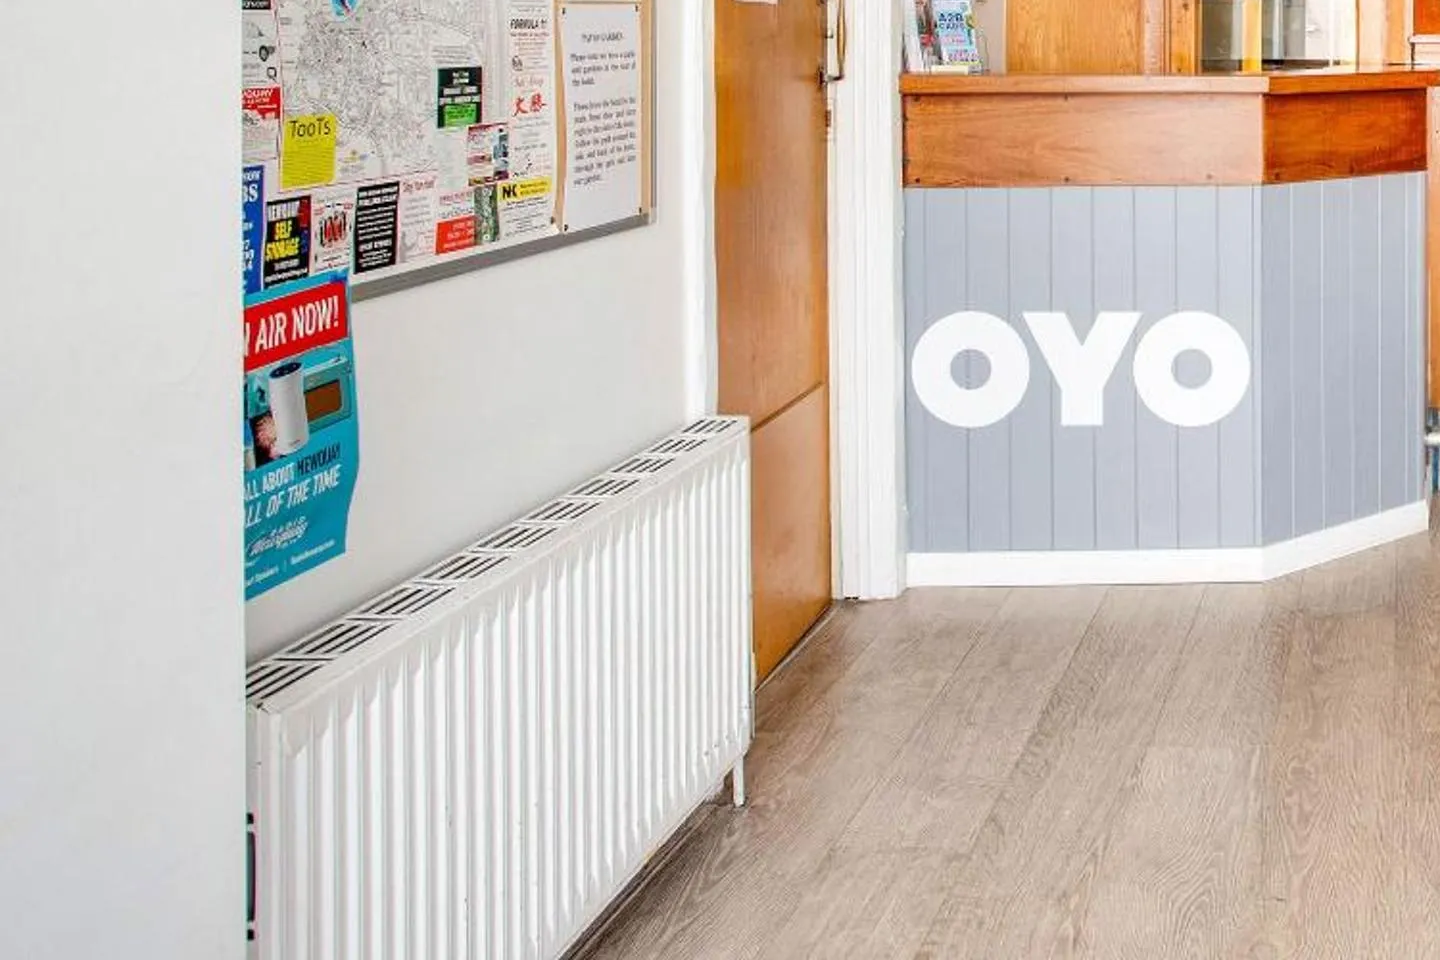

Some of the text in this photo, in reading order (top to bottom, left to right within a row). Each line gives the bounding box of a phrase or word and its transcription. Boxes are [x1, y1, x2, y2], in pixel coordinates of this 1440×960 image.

[254, 294, 339, 355] AIR NOW!
[911, 310, 1251, 428] OYO
[262, 462, 296, 494] ABOUT
[266, 490, 285, 518] OF
[287, 477, 311, 509] THE
[313, 463, 342, 497] TIME
